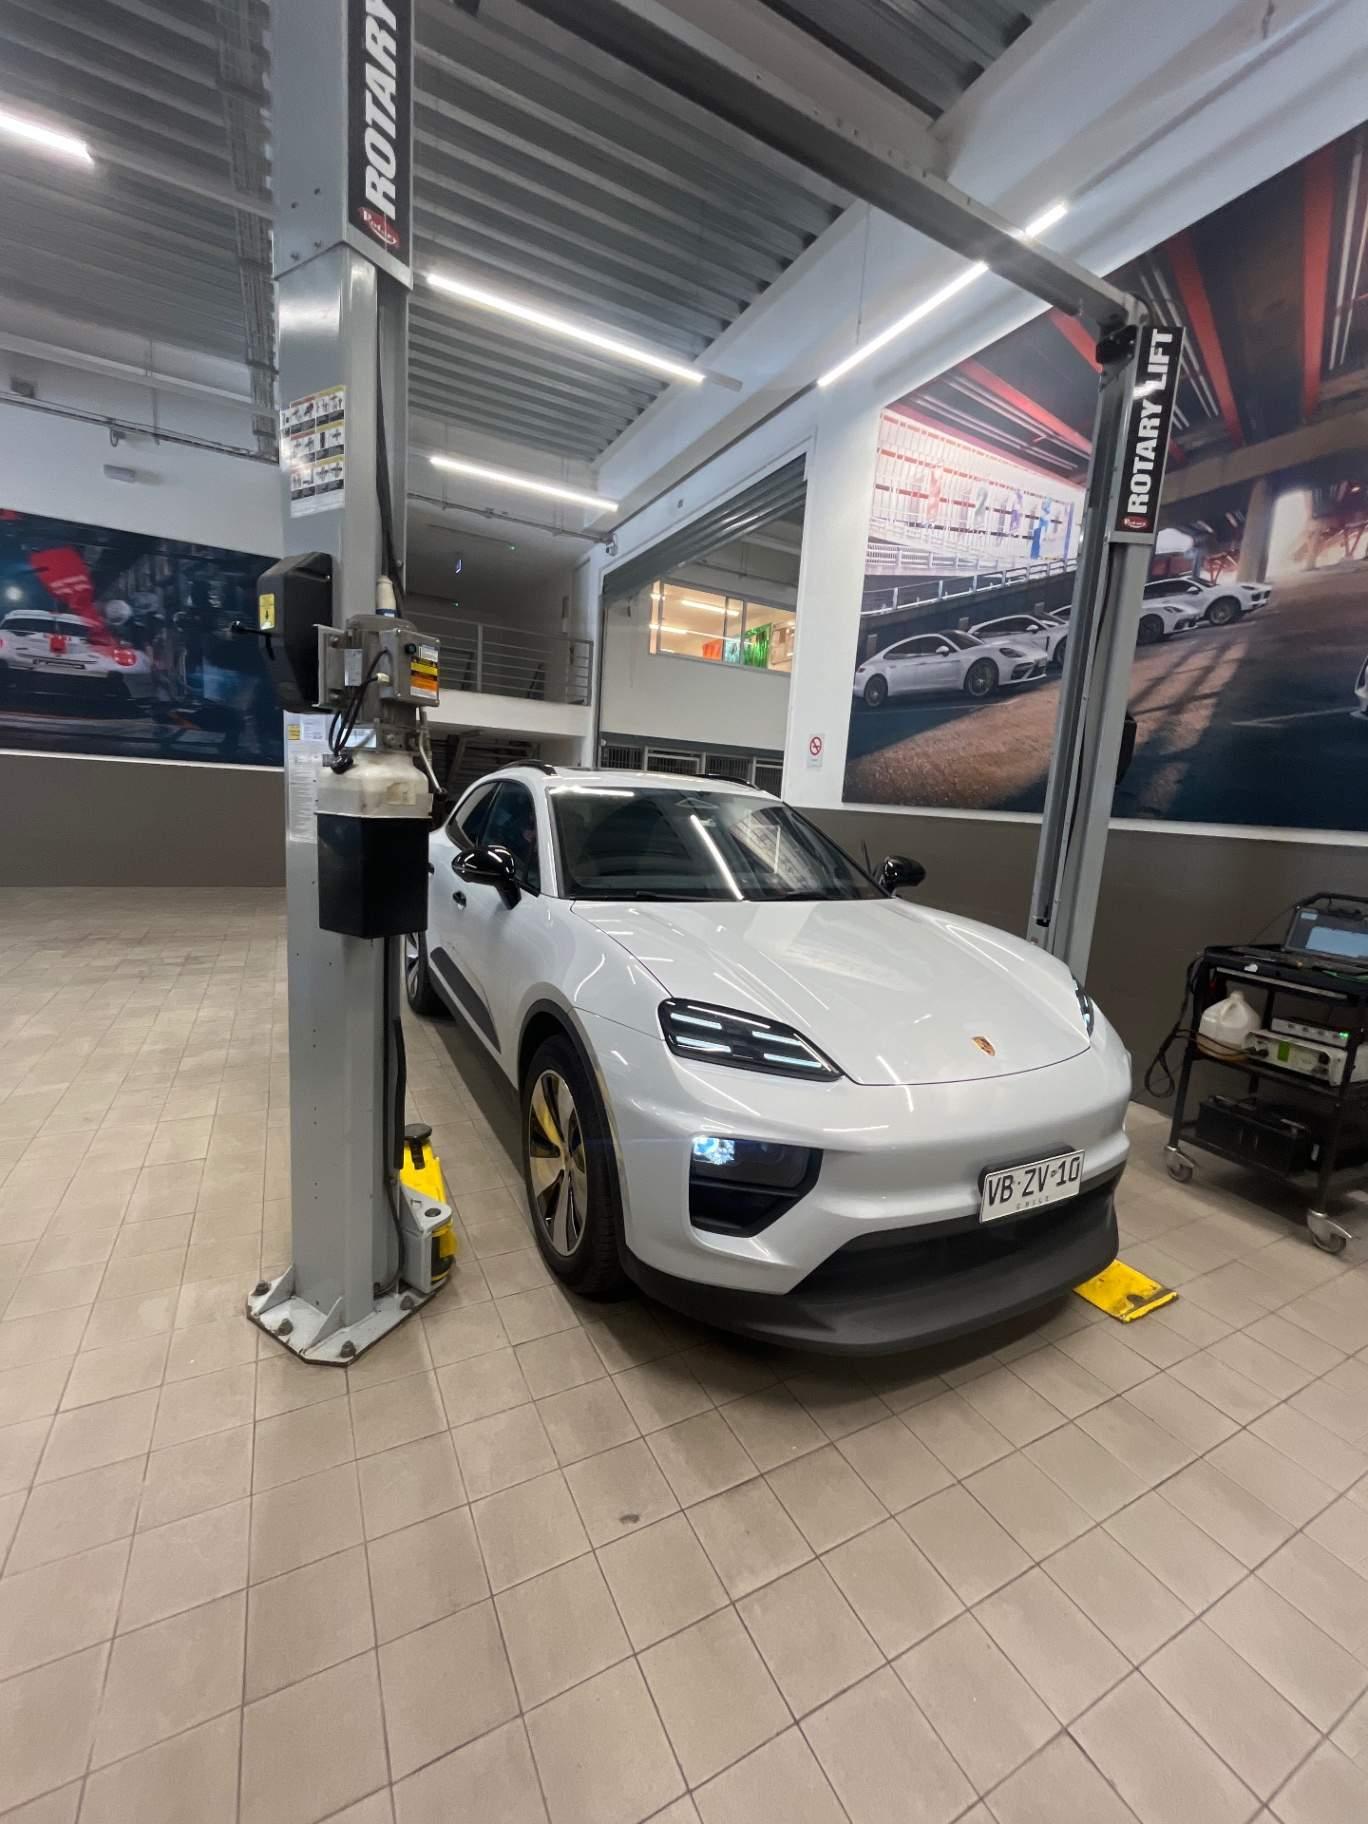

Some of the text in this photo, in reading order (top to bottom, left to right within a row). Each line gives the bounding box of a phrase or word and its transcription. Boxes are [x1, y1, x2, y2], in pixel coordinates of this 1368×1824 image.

[366, 0, 396, 221] ROTARY
[1127, 328, 1173, 514] ROTARY LIFT
